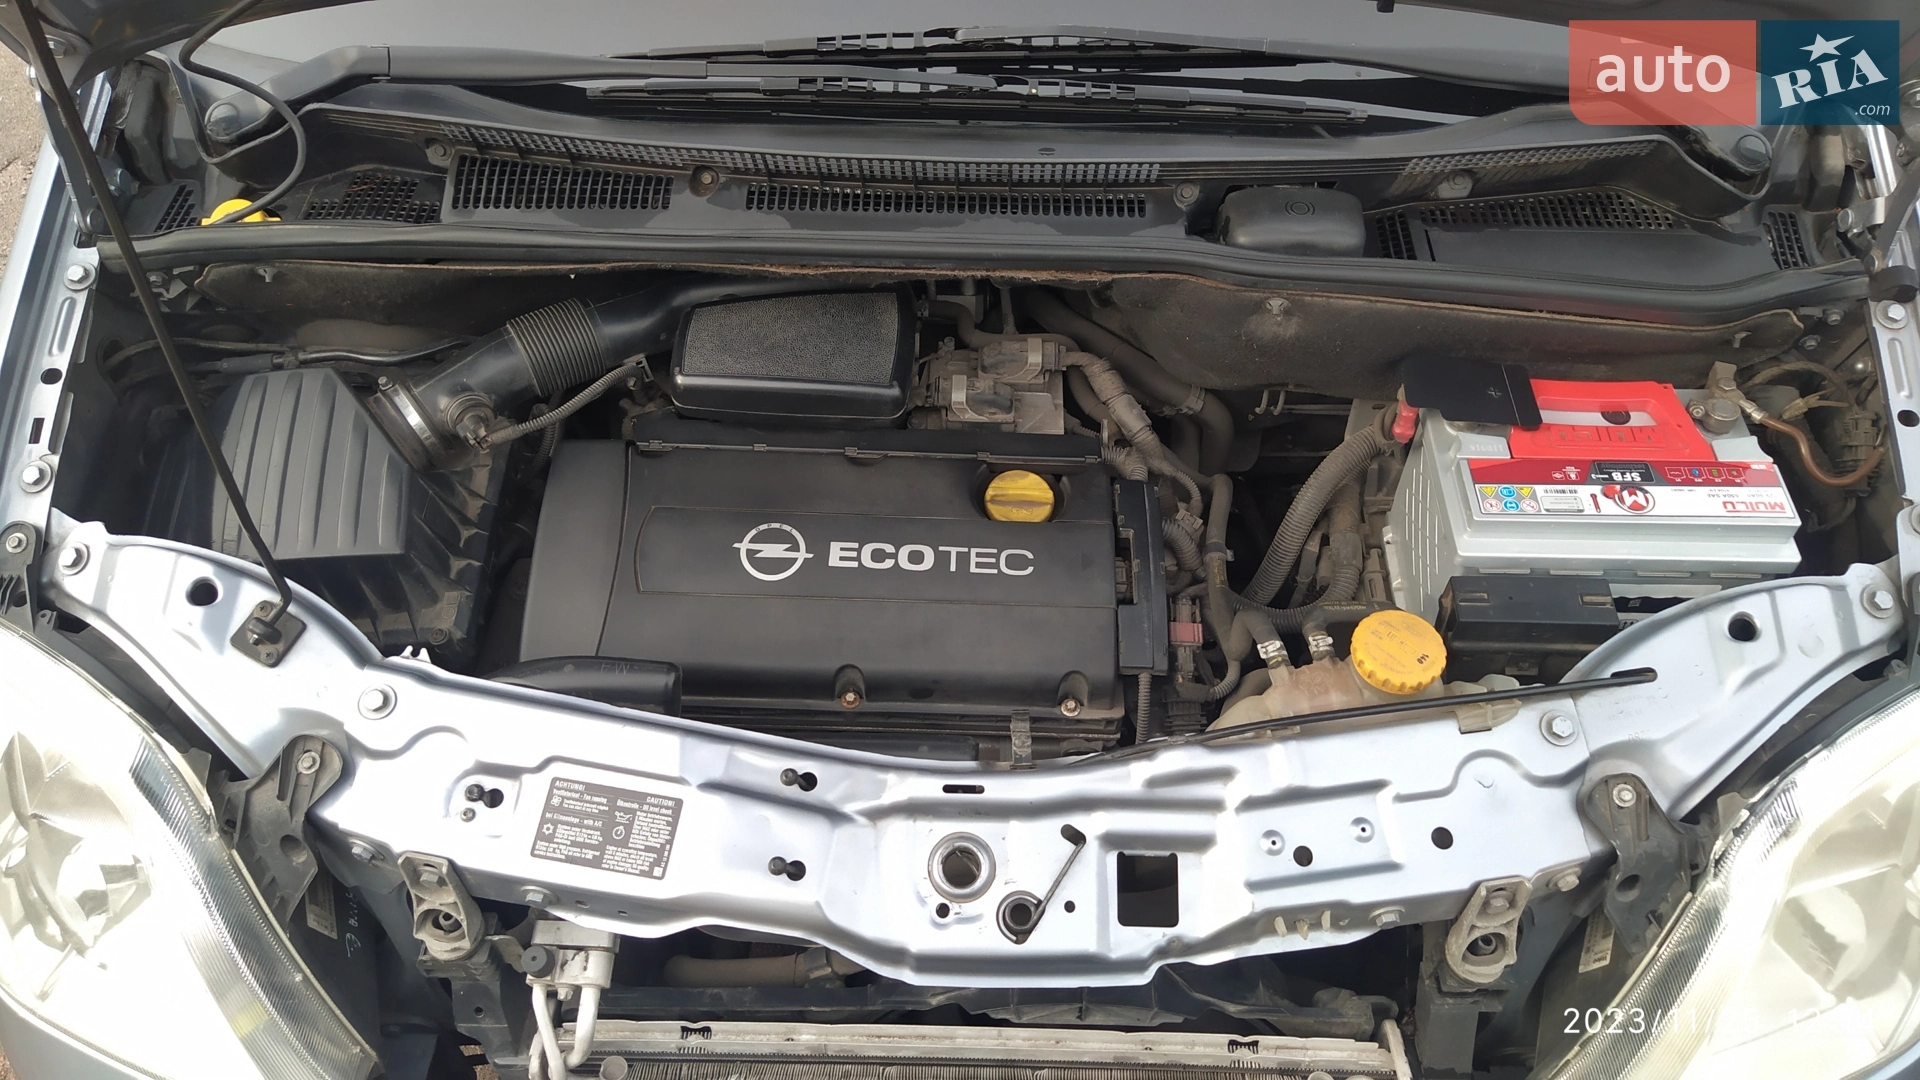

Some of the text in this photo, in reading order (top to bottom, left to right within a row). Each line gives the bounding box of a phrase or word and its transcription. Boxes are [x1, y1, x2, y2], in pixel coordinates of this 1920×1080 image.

[1612, 472, 1642, 482] SFB
[1722, 500, 1786, 514] MUTLU
[754, 523, 794, 534] OPEL
[828, 541, 1035, 576] ECOTEC
[555, 781, 586, 791] ACHTUNG!
[646, 796, 676, 806] CAUTION!
